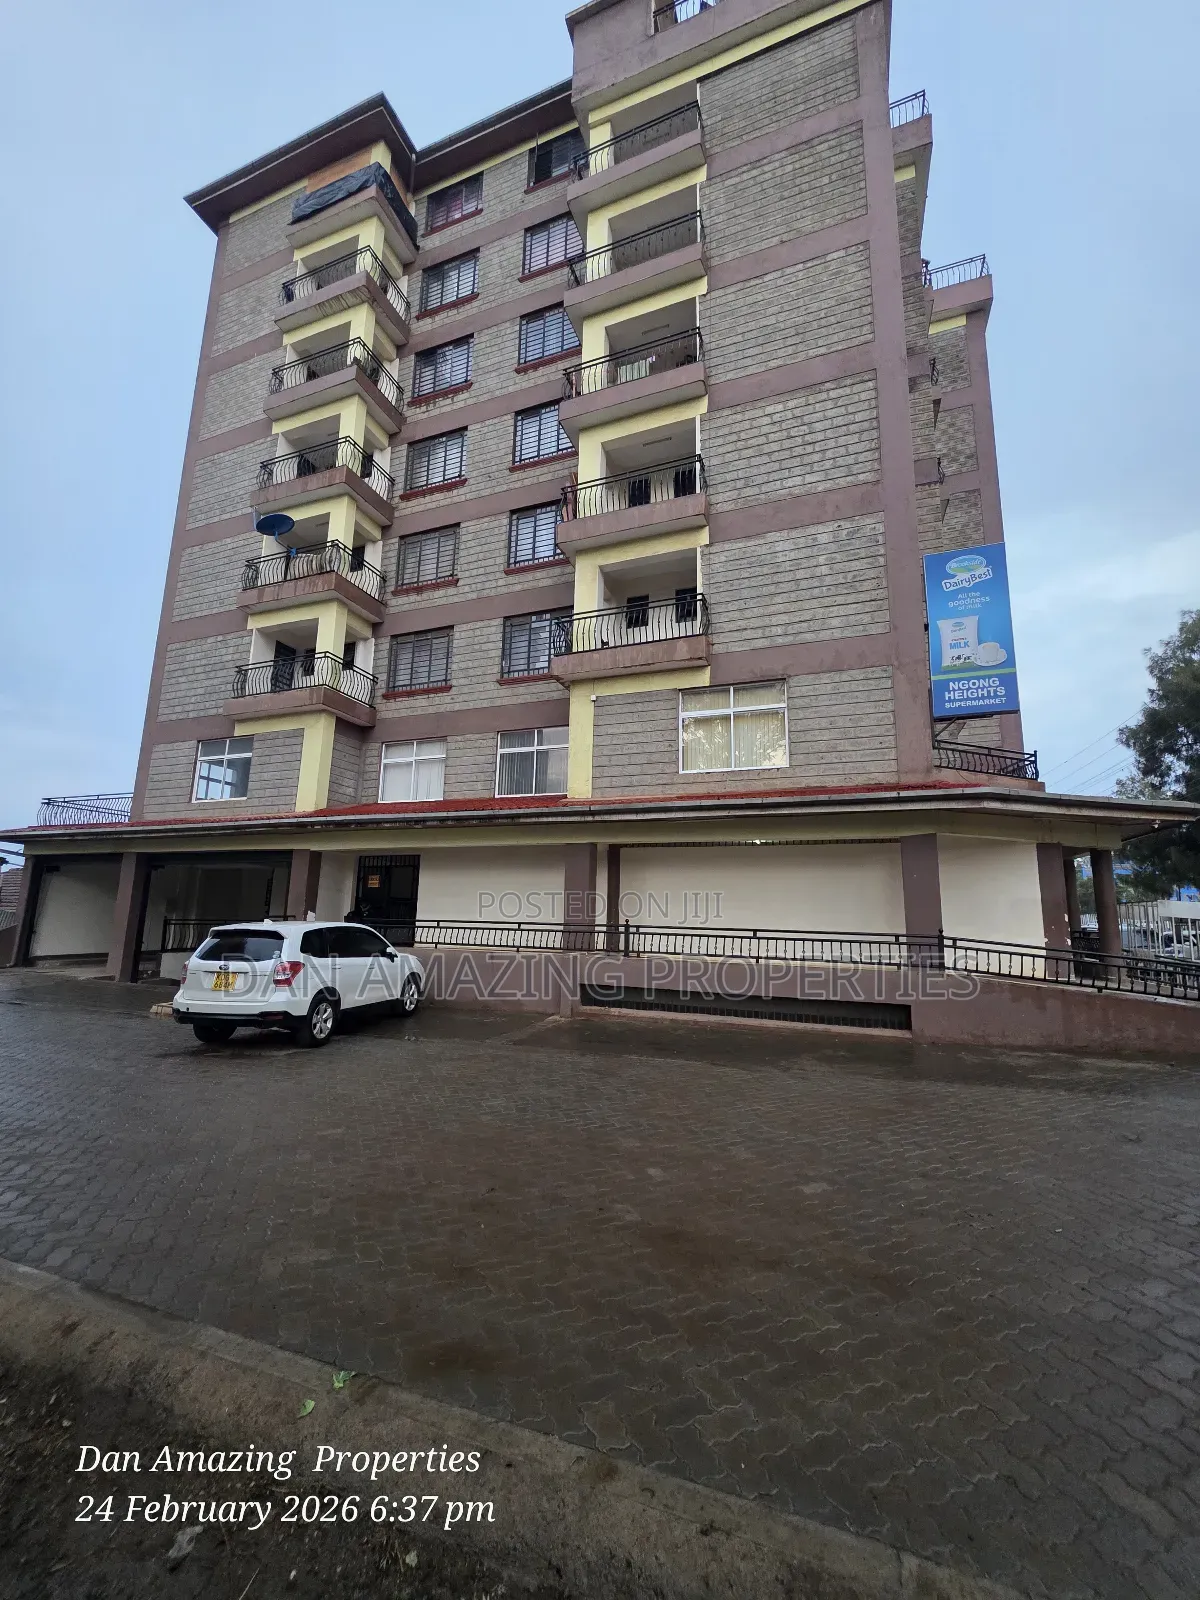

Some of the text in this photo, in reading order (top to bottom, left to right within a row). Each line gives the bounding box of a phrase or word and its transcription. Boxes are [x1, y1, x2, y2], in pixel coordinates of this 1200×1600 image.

[944, 569, 991, 590] DairyBest
[948, 596, 990, 607] goodness
[949, 641, 970, 650] MILK
[949, 678, 999, 690] NGONG
[945, 687, 1005, 700] HEIGHTS
[945, 698, 1006, 708] SUPERMARKET
